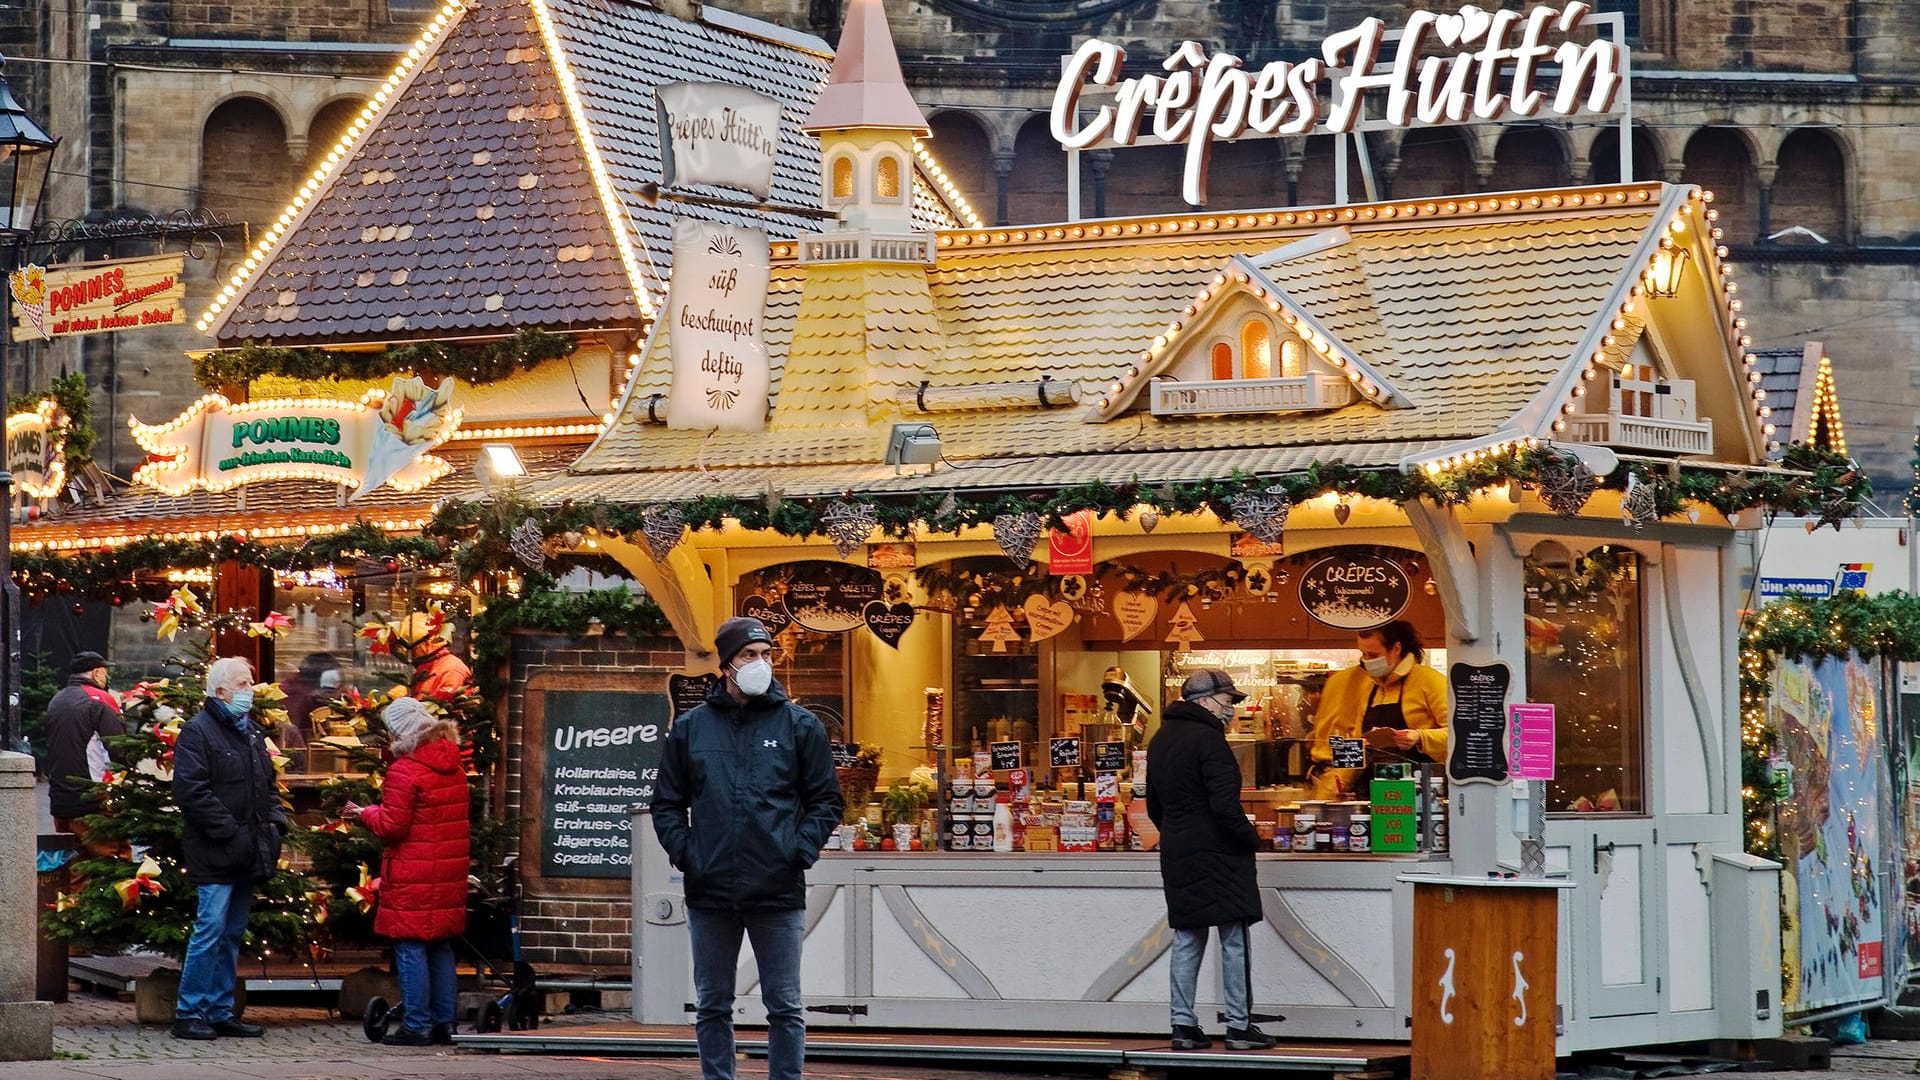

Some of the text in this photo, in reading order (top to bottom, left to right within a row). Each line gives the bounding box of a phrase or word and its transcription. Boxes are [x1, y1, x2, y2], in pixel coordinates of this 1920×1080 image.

[1050, 38, 1326, 206] Crêpes
[50, 267, 125, 316] POMMES
[708, 267, 738, 298] süß
[53, 307, 175, 334] mit vielen leckeren Soßen!
[680, 304, 753, 341] beschwipst
[701, 349, 744, 384] deftig
[231, 416, 341, 448] POMMES
[241, 448, 289, 466] frischen
[289, 447, 352, 470] Kartoffeln
[1326, 561, 1387, 582] CRÊPES
[747, 607, 786, 625] CRÊPES
[869, 612, 912, 625] CRÊPES
[554, 723, 658, 752] Unsere
